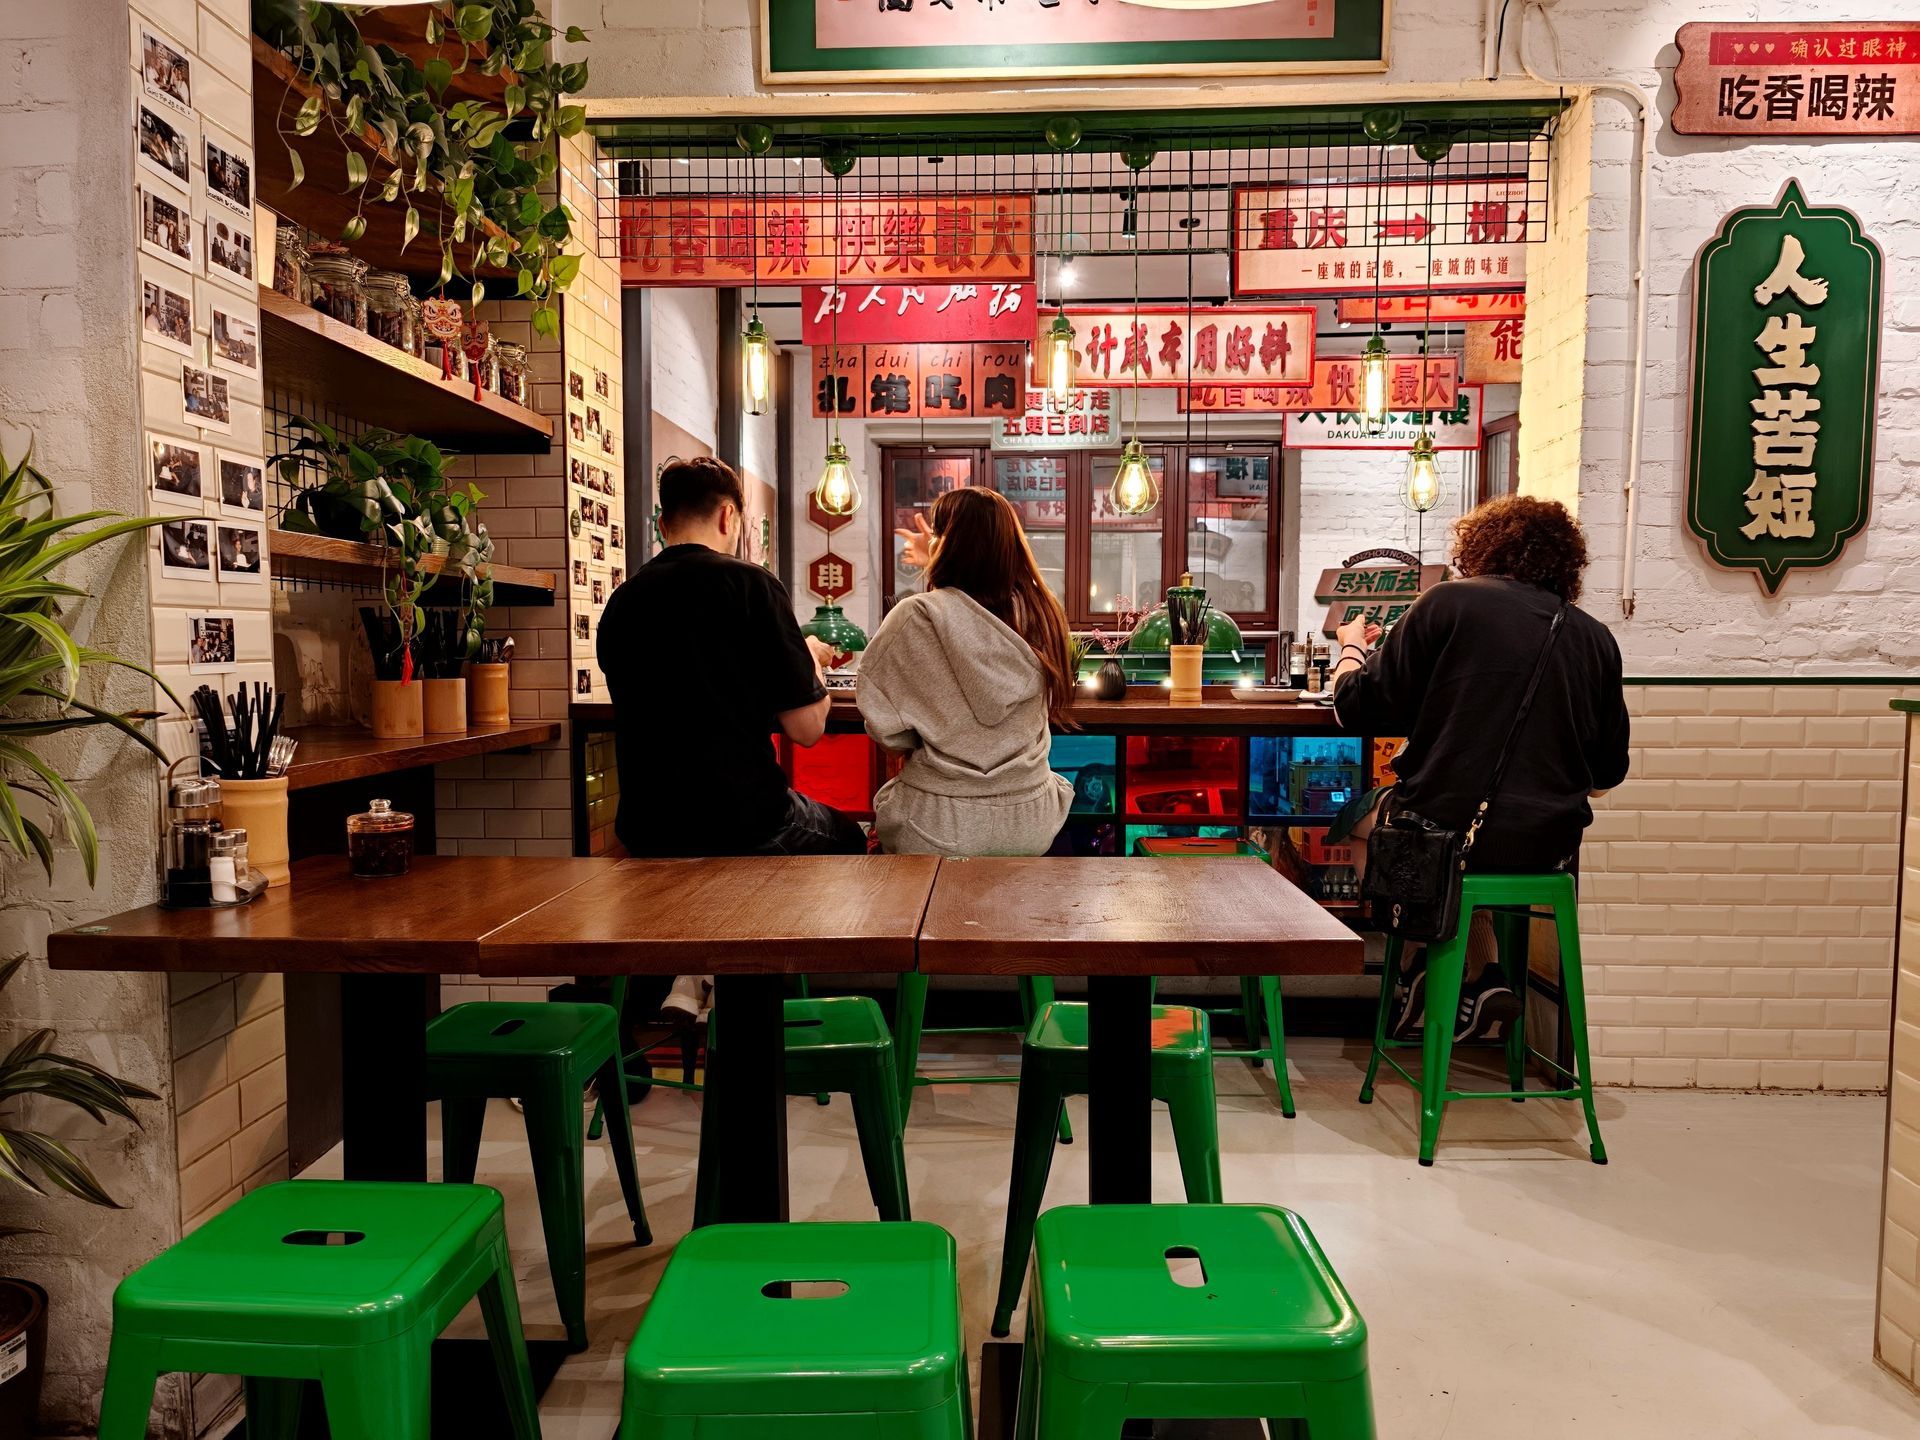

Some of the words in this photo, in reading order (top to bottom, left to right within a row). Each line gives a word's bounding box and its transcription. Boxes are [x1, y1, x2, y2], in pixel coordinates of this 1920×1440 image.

[1718, 73, 1897, 121] 吃香喝辣
[620, 207, 810, 275] 吃香喝辣
[833, 205, 1024, 275] 快樂最大
[1259, 206, 1348, 250] 重庆
[819, 351, 857, 368] zha
[875, 350, 909, 367] dui
[931, 350, 962, 367] chi
[983, 354, 1019, 367] rou
[1074, 320, 1292, 379] 计成本用好料
[1327, 364, 1450, 406] 快最大
[1738, 234, 1829, 541] 人生苦短
[1003, 414, 1110, 436] 五更已到店
[1388, 430, 1405, 439] JIU
[1409, 430, 1436, 439] DIN
[817, 562, 844, 590] 串
[1333, 569, 1421, 594] 尽兴而去
